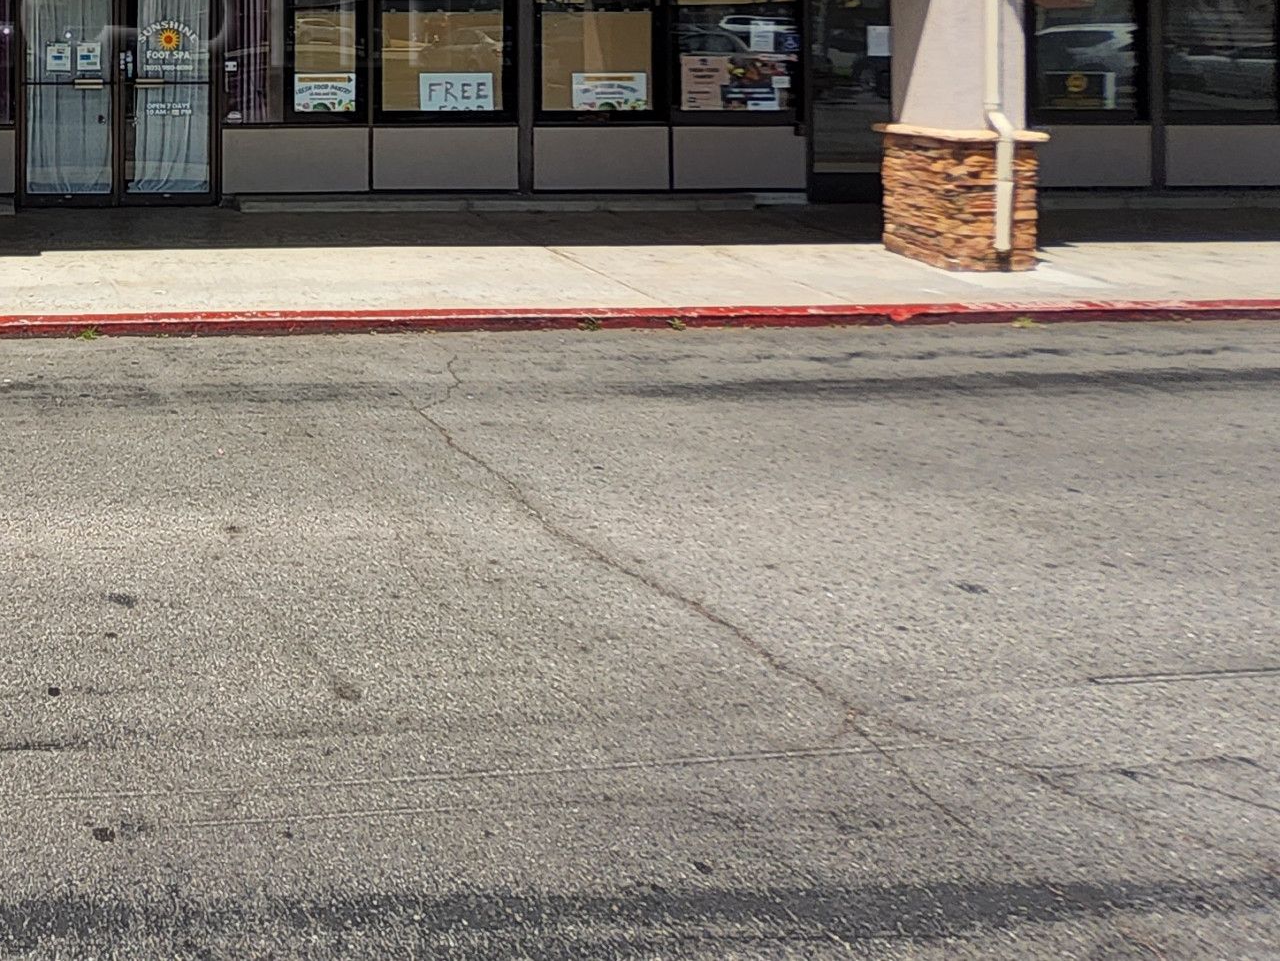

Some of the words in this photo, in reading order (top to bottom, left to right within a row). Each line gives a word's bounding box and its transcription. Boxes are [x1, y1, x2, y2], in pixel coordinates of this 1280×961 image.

[138, 20, 198, 44] SUNSHINE
[146, 50, 170, 59] FOOT
[172, 50, 191, 59] SPA
[428, 81, 488, 102] FREE
